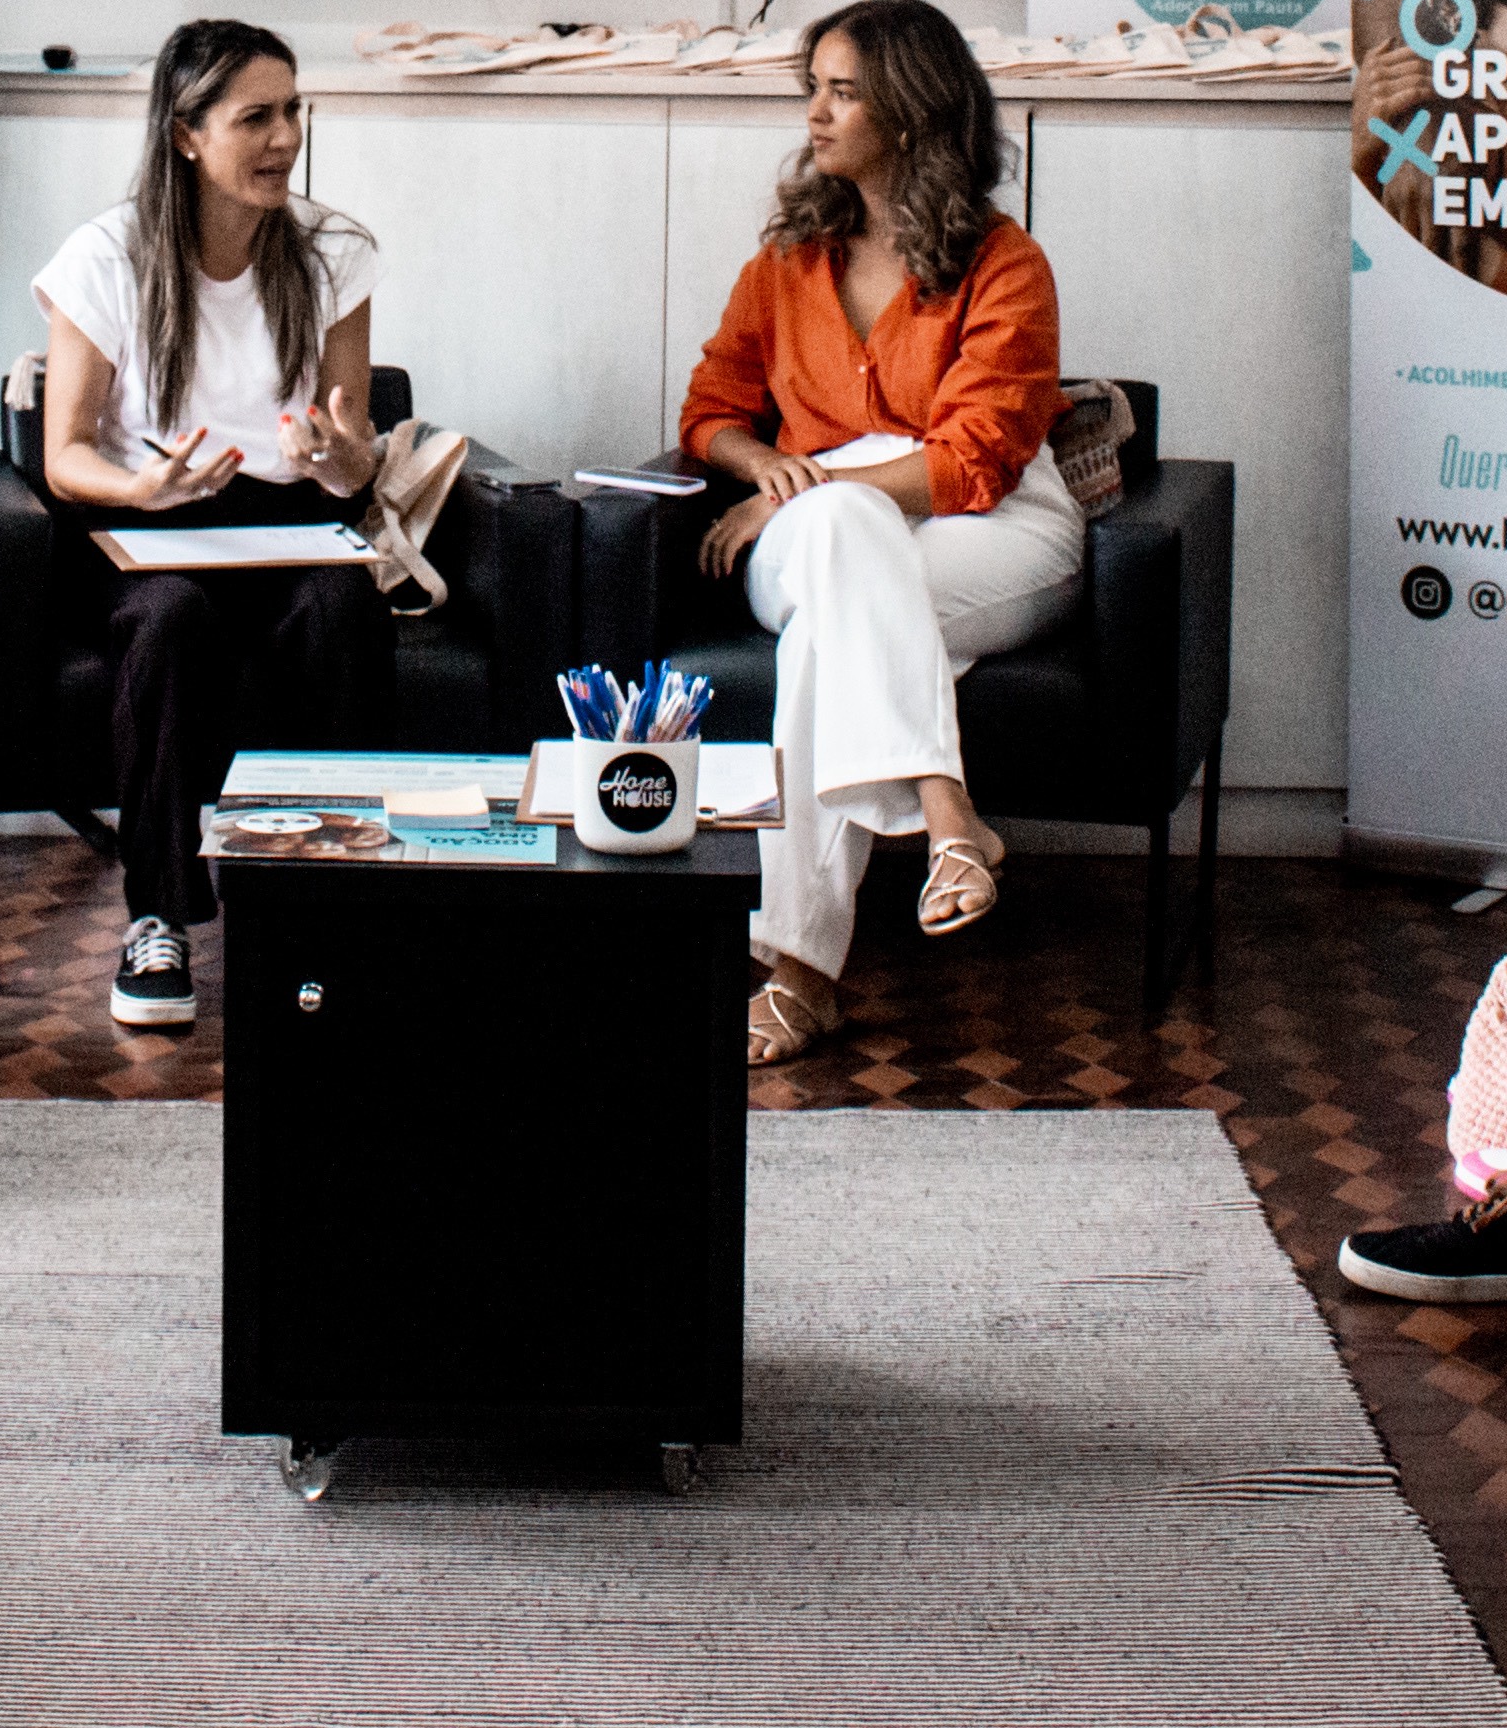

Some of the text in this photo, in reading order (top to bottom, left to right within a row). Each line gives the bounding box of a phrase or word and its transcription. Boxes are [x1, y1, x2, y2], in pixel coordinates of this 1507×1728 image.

[1255, 0, 1304, 16] Pauta
[599, 765, 668, 794] Hope
[613, 790, 673, 808] HOUSE
